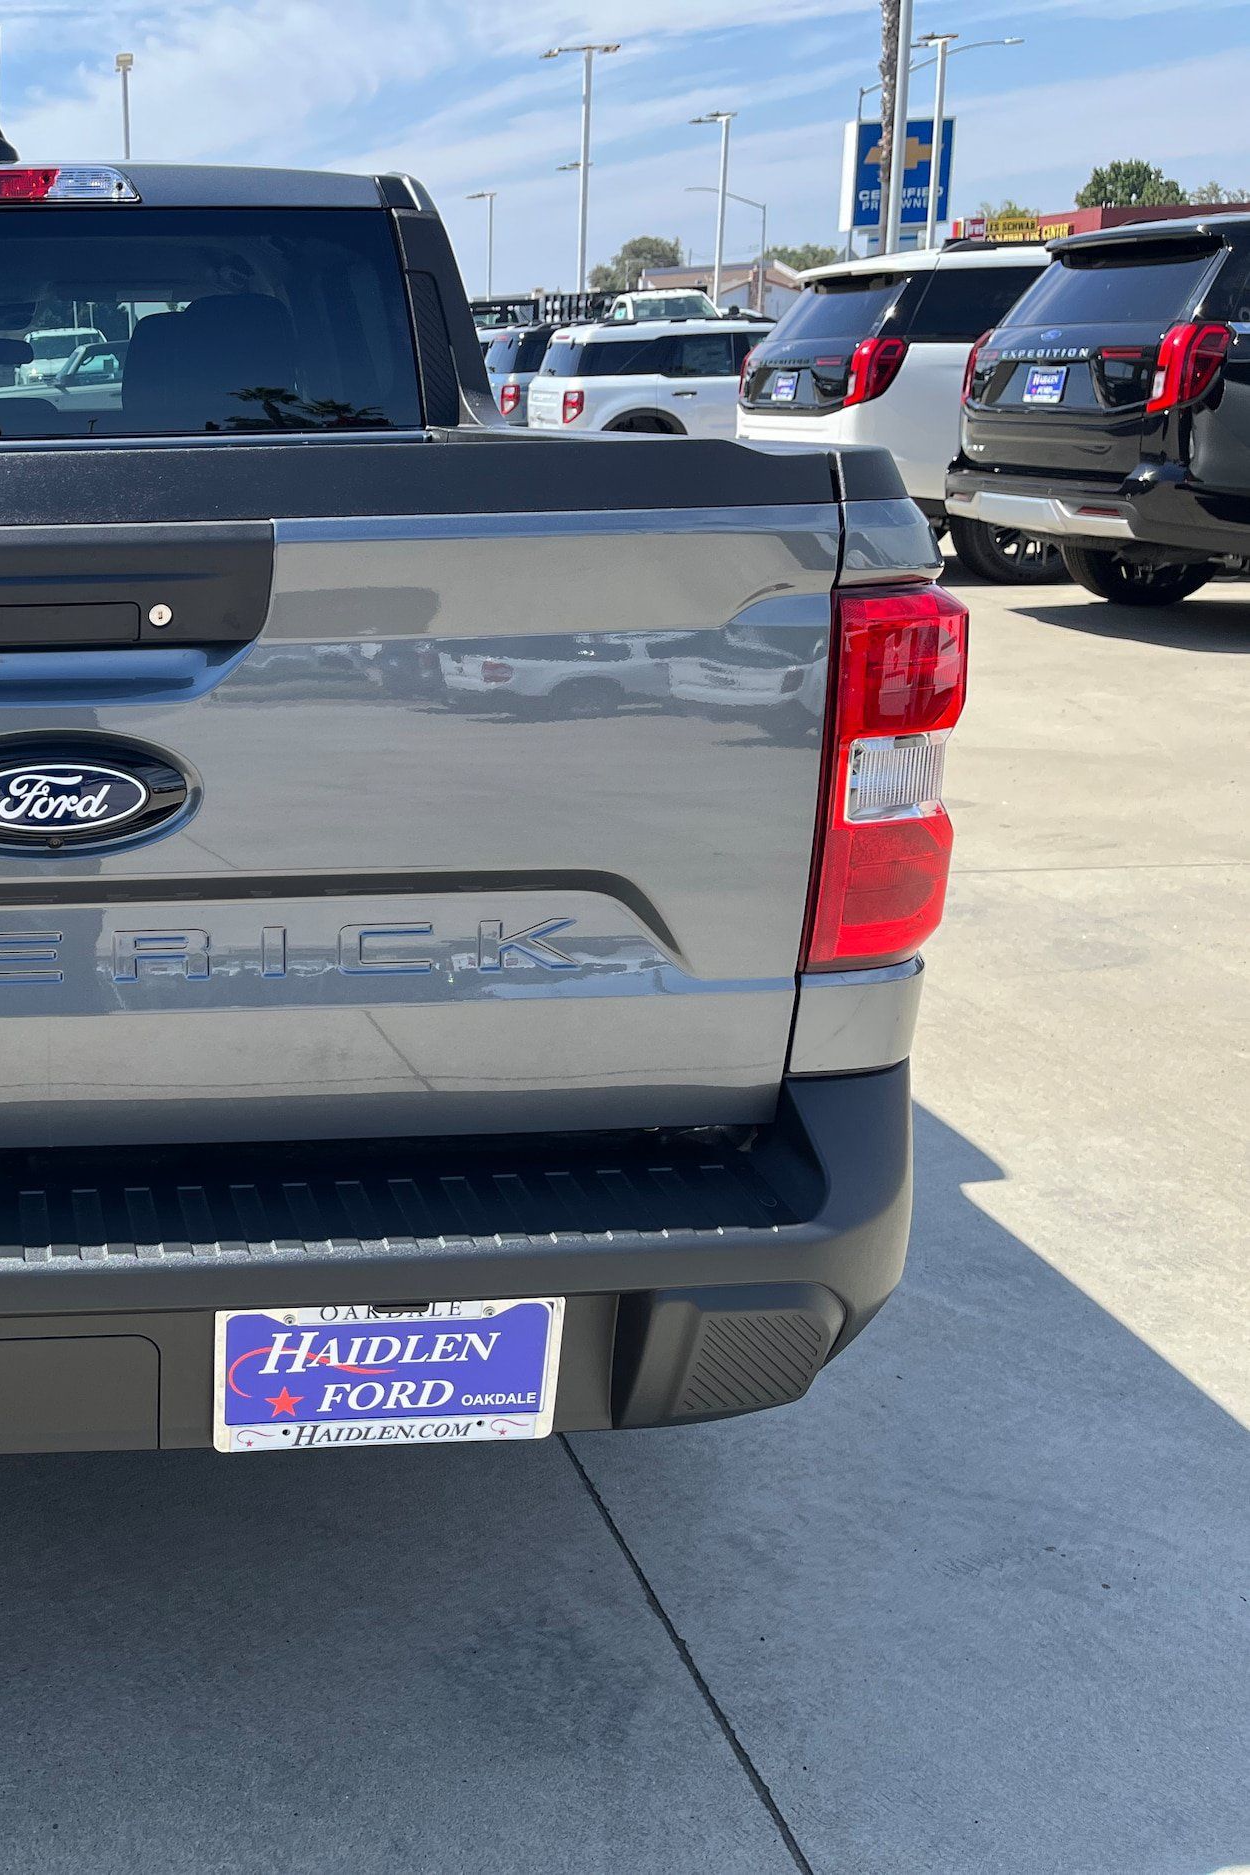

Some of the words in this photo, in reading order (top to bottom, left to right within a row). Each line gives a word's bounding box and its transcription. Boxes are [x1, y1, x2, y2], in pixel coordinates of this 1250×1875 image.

[858, 186, 944, 201] CEIFIED
[1002, 220, 1036, 232] SCHWAB
[1001, 347, 1090, 360] EXPEDITION
[258, 1331, 502, 1375] HAIDLEN
[316, 1379, 455, 1412] FORD
[461, 1391, 537, 1407] OAKDALE
[292, 1420, 475, 1447] HAIDLEN.COM
